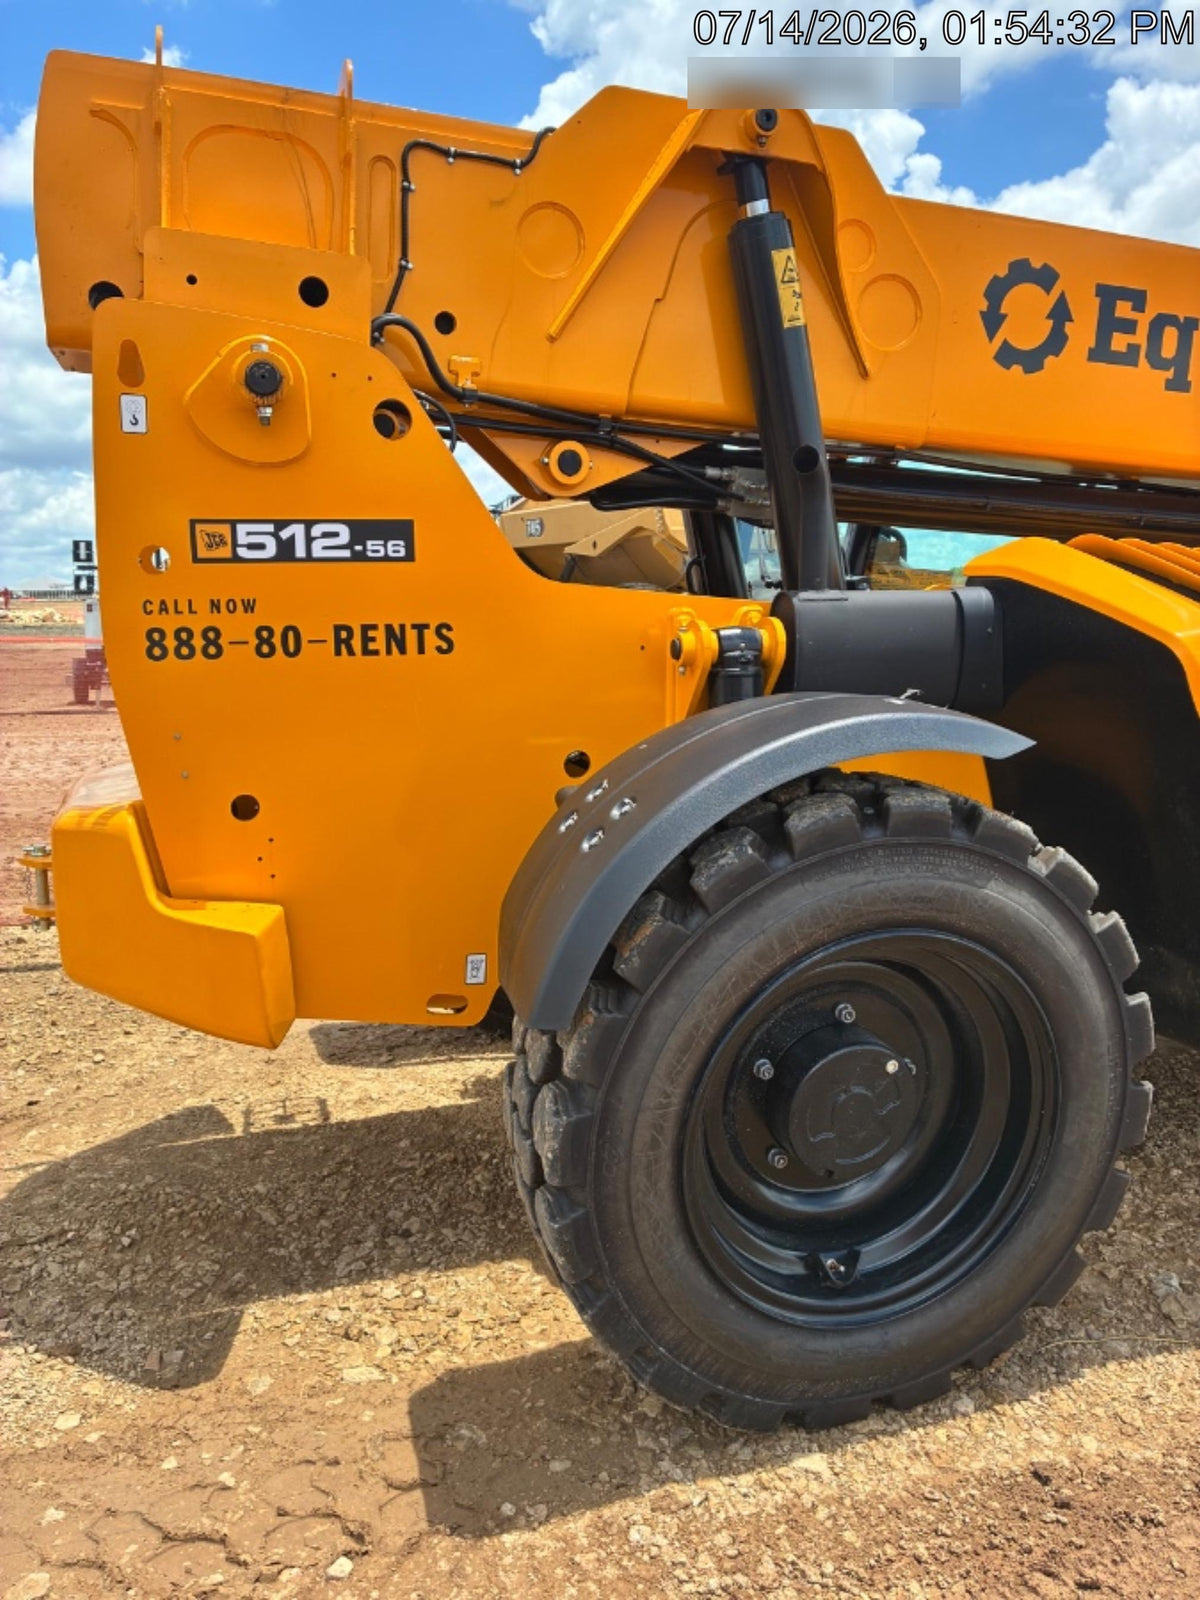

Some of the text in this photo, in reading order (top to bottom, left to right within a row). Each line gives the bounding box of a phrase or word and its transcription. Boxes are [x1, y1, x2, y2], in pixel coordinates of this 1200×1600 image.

[142, 597, 257, 616] CALL NOW
[144, 622, 455, 662] 888-80-RENTS
